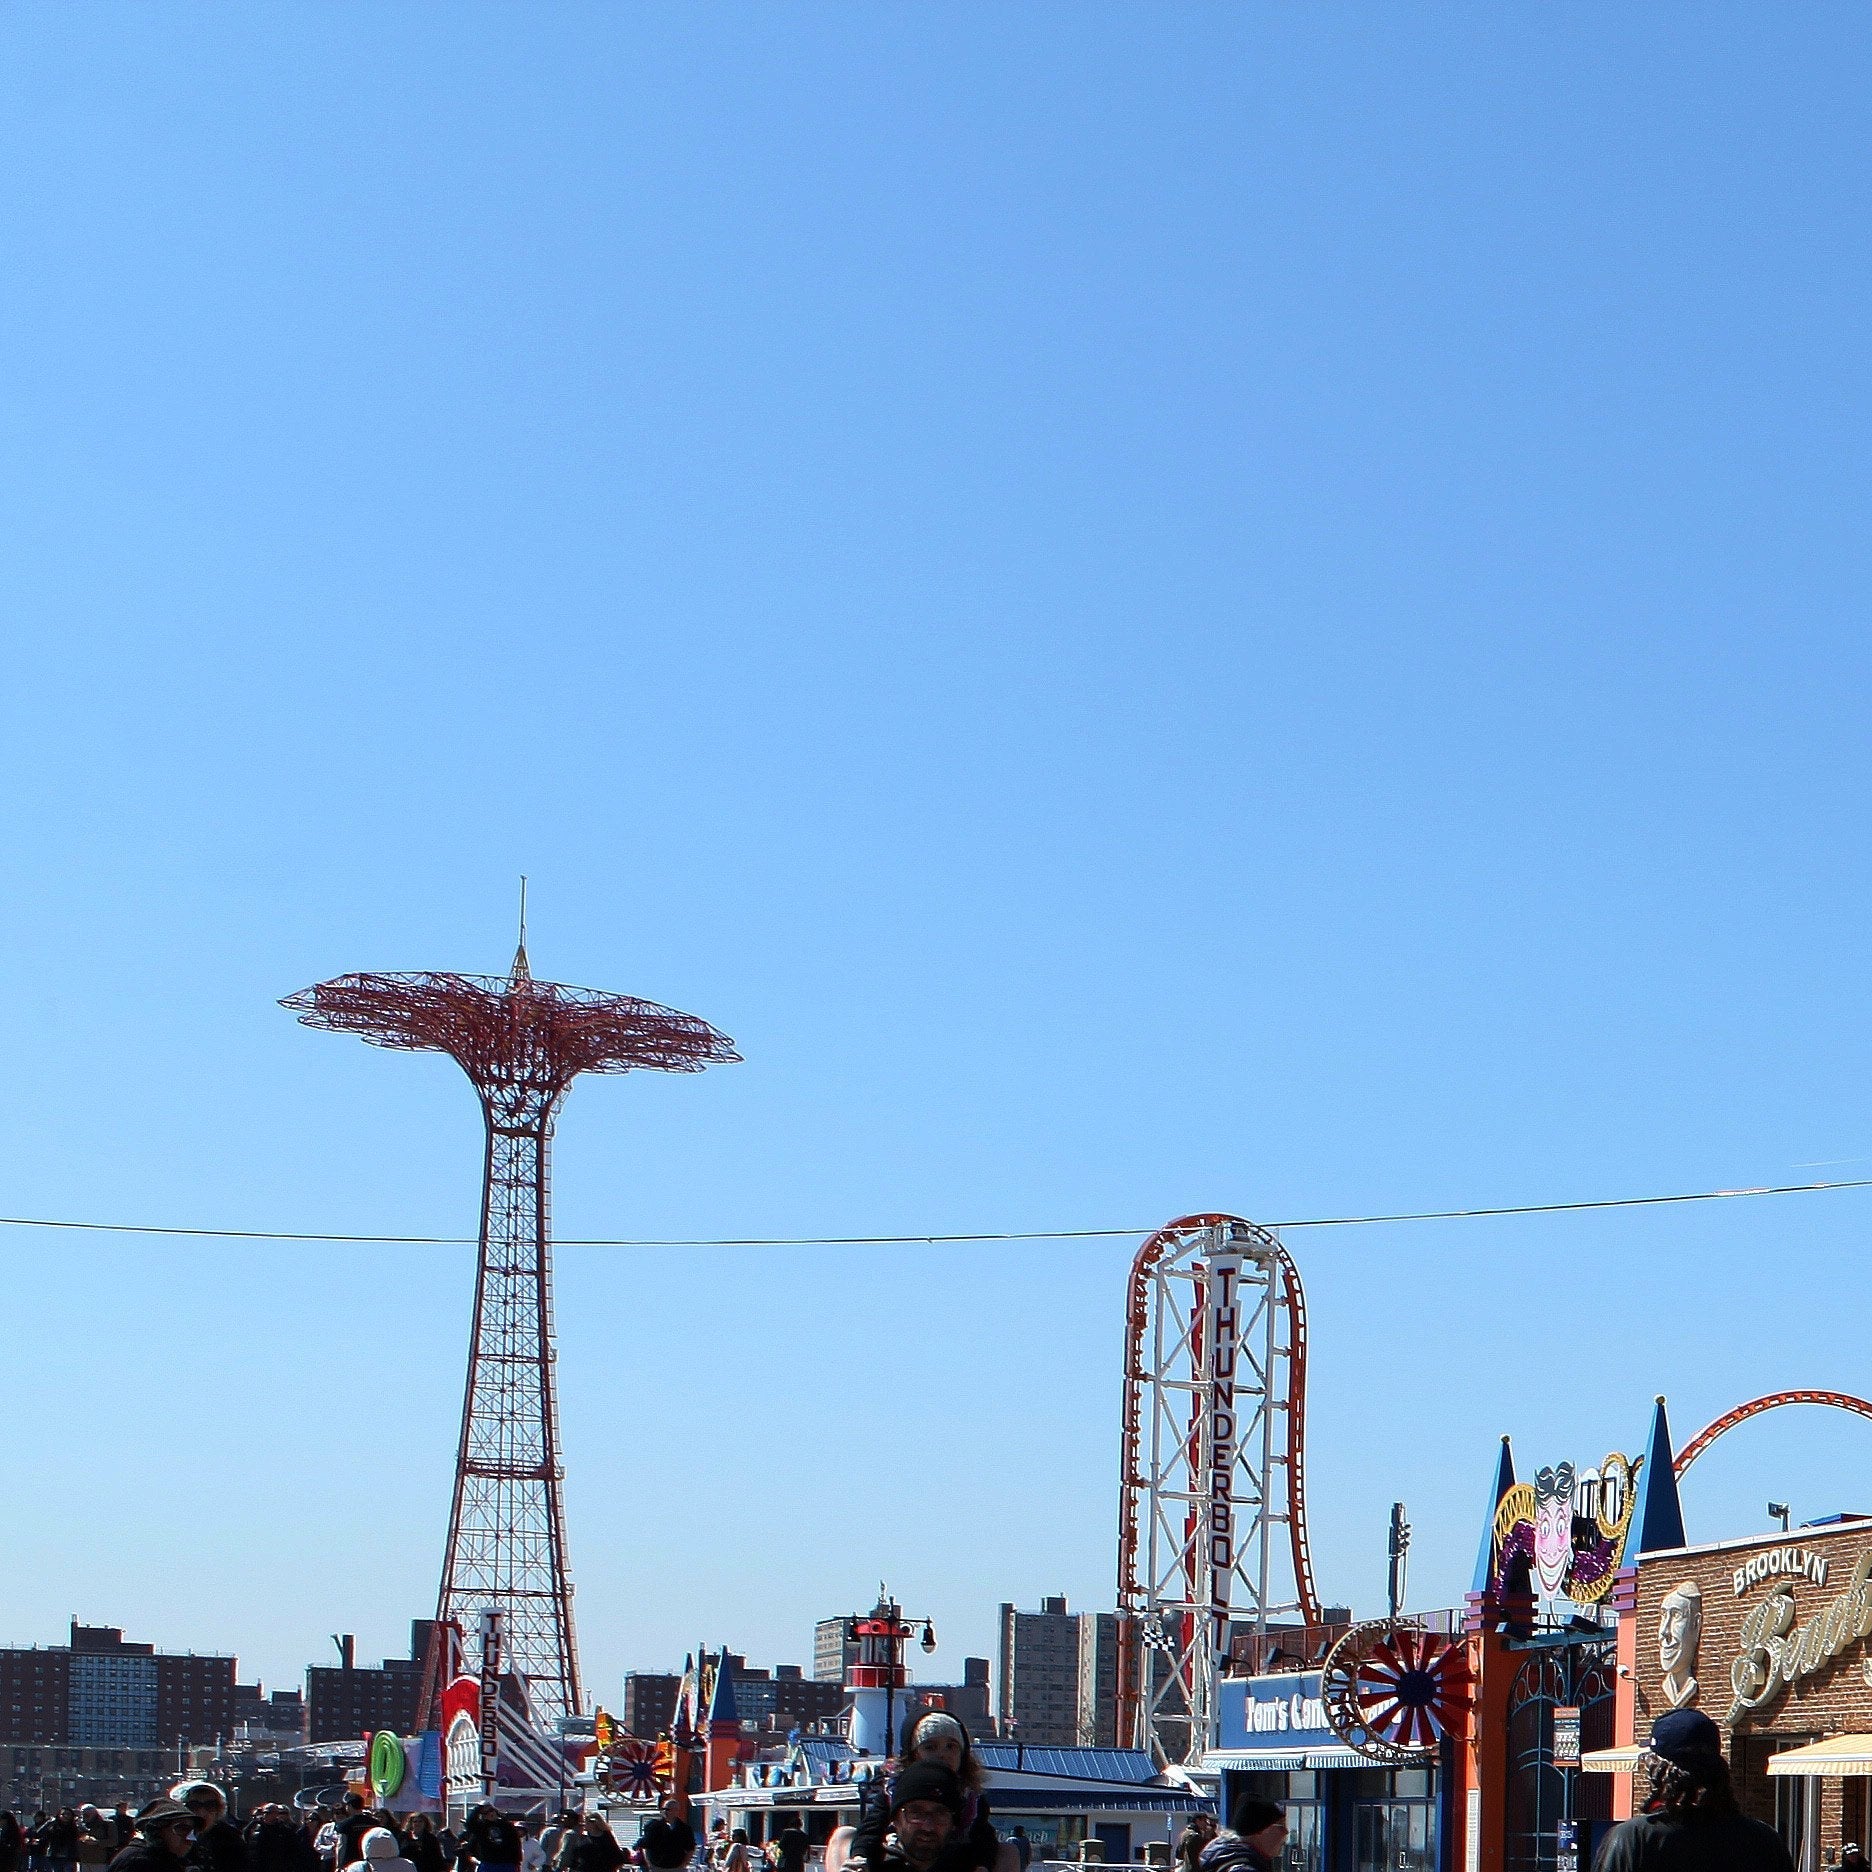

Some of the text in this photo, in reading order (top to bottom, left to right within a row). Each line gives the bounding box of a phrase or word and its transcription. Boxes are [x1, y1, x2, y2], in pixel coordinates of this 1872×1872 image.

[1211, 1267, 1237, 1652] THUNDERBOLT
[1733, 1546, 1830, 1597] BROOKLYN
[481, 1614, 502, 1797] THUNDERBOLT
[1245, 1695, 1288, 1733] Tom's
